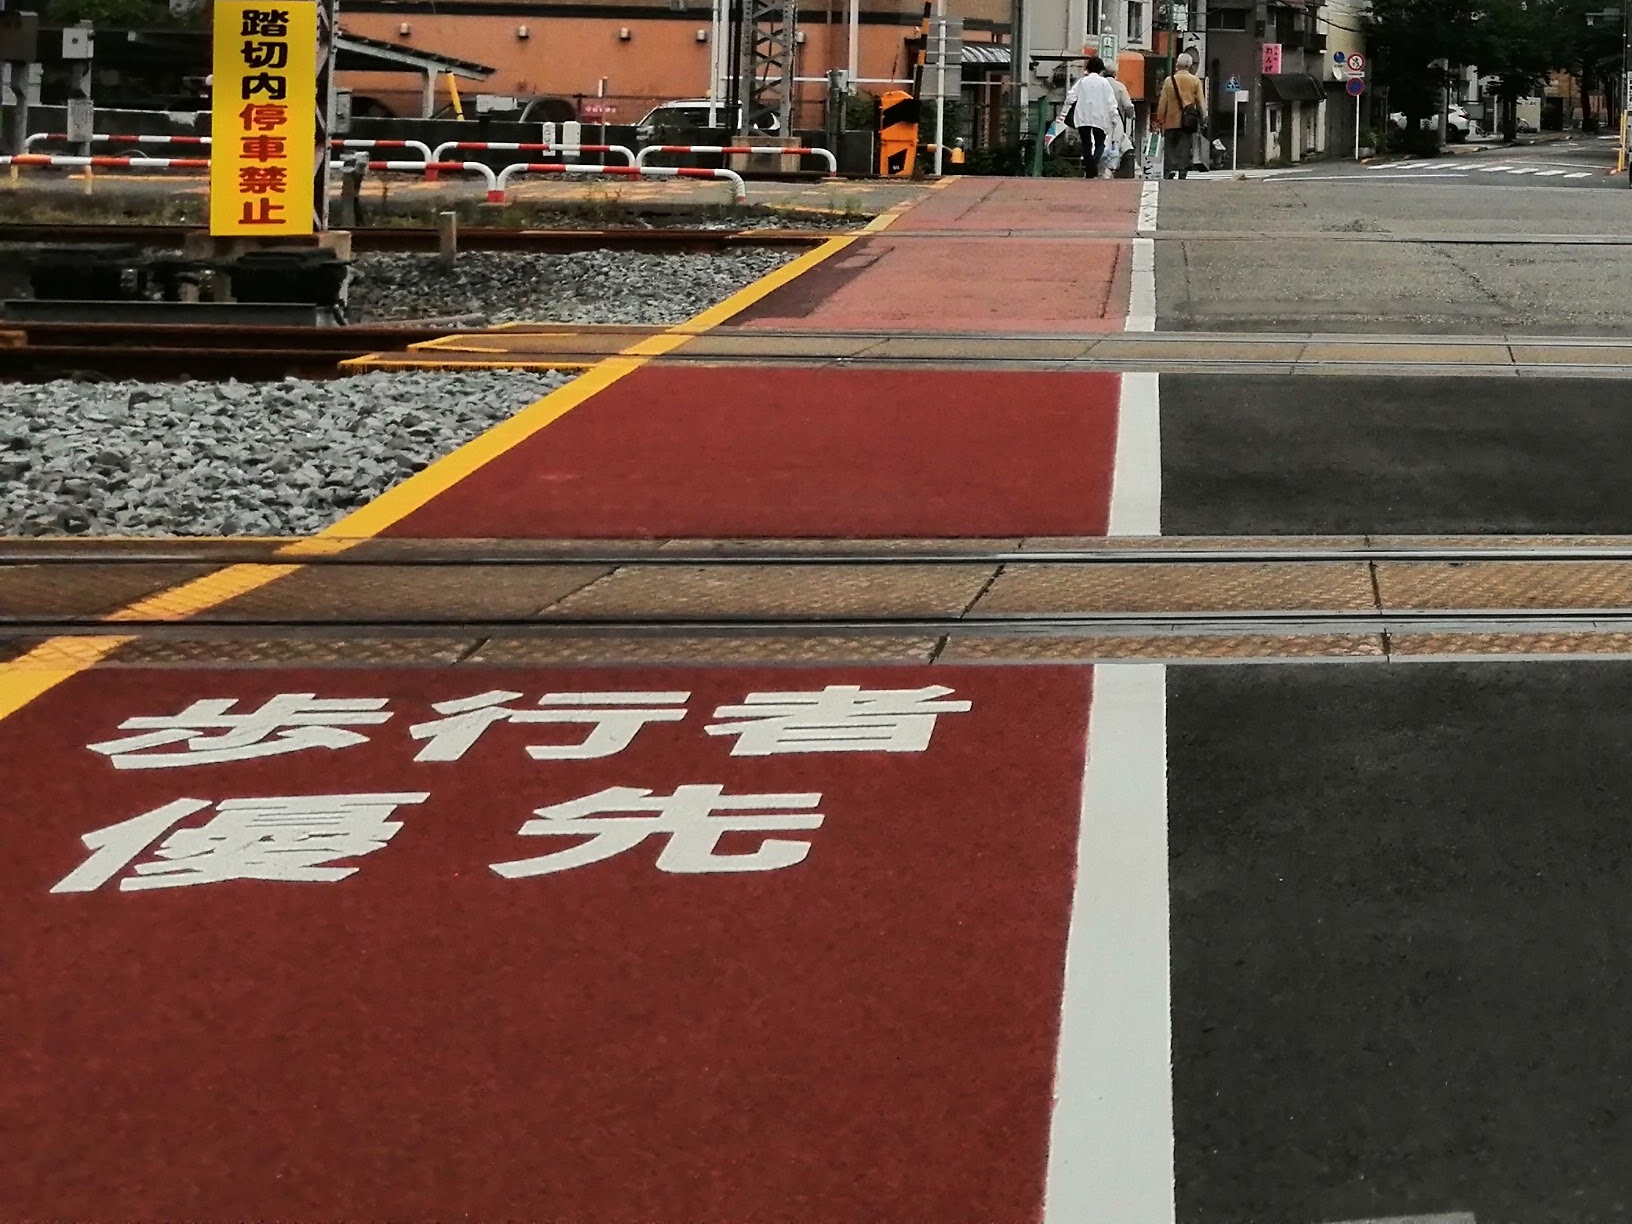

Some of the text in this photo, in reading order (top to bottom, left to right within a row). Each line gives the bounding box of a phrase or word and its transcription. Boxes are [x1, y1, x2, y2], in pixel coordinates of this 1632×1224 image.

[238, 9, 289, 225] 踏切内停車禁止
[86, 685, 972, 770] 歩行者
[49, 784, 825, 894] 優先
